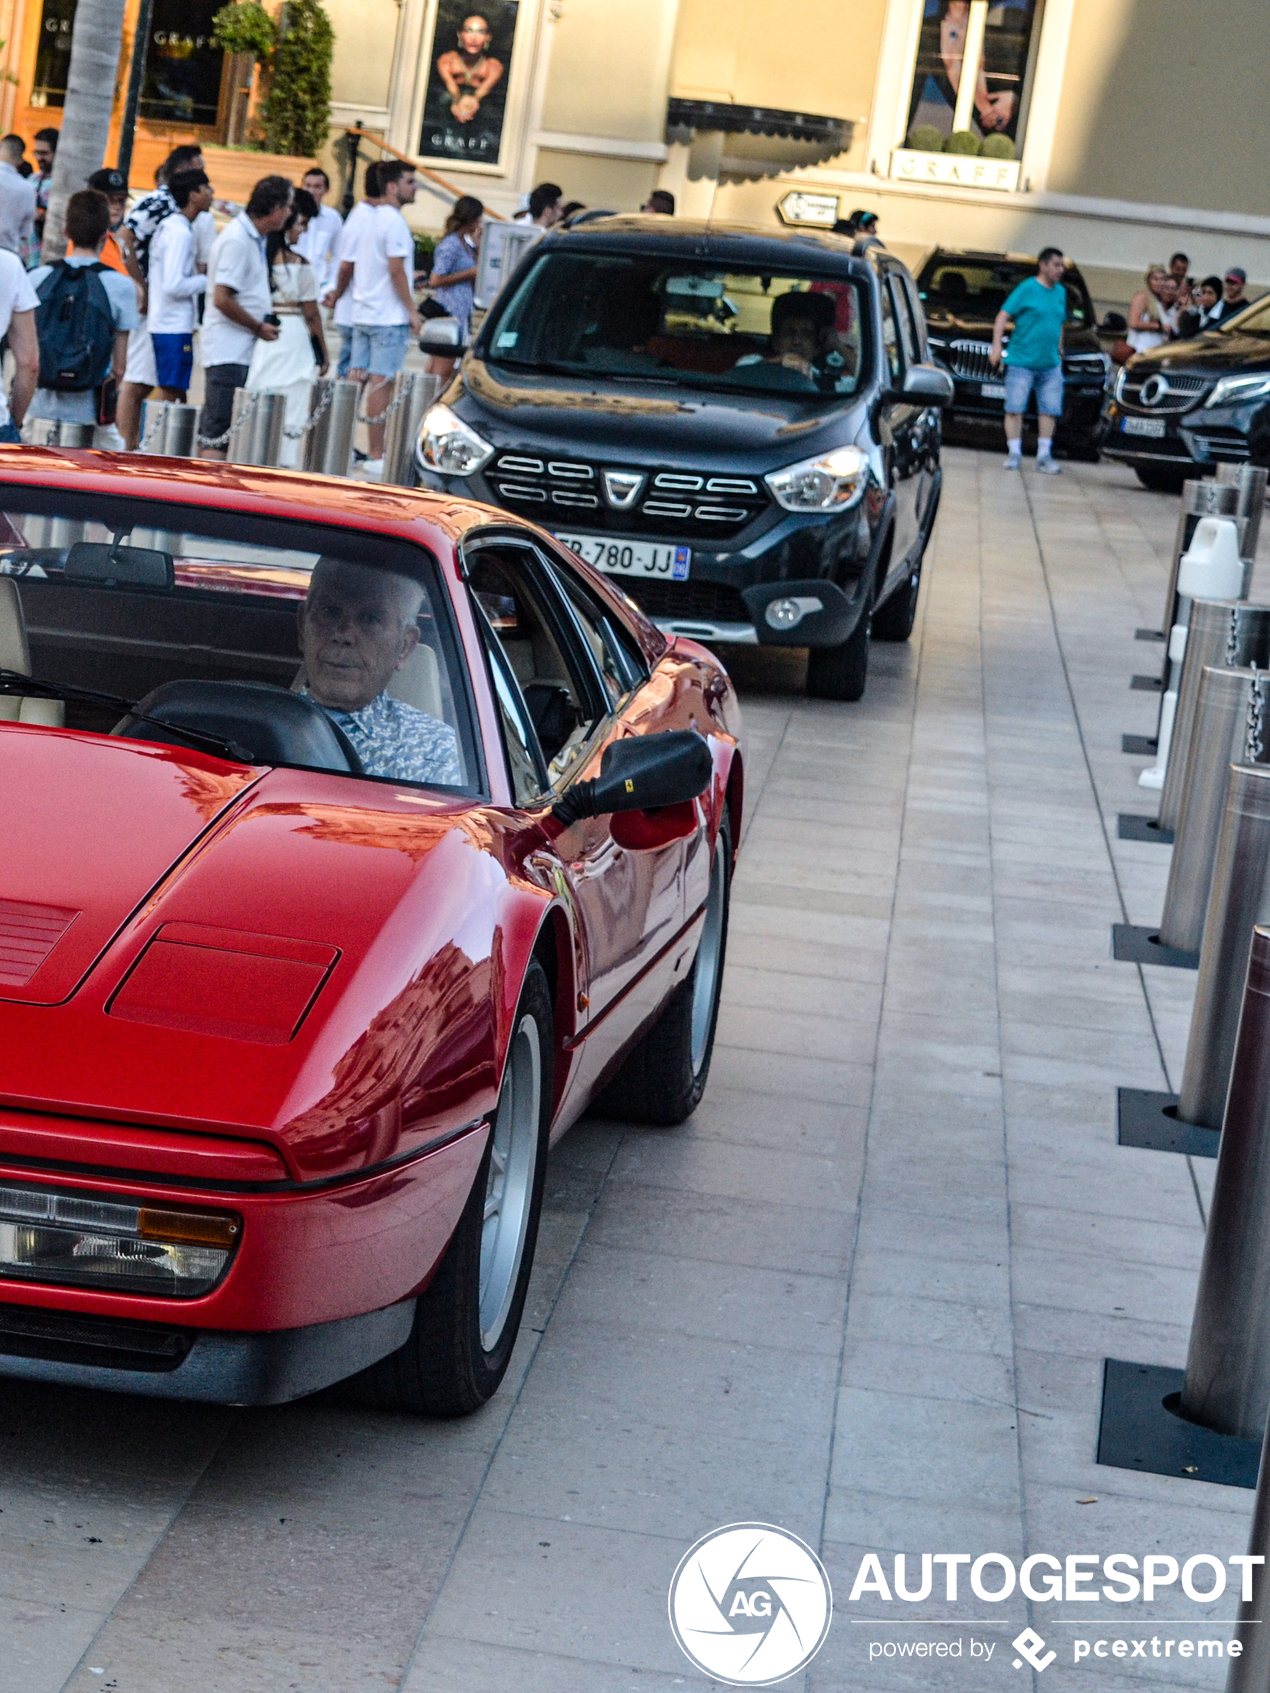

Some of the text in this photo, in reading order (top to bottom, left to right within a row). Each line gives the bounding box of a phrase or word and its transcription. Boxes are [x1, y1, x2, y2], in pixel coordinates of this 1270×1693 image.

[431, 132, 489, 151] GRAFF
[901, 158, 1009, 184] GRAFF
[559, 538, 672, 573] R-780-JJ
